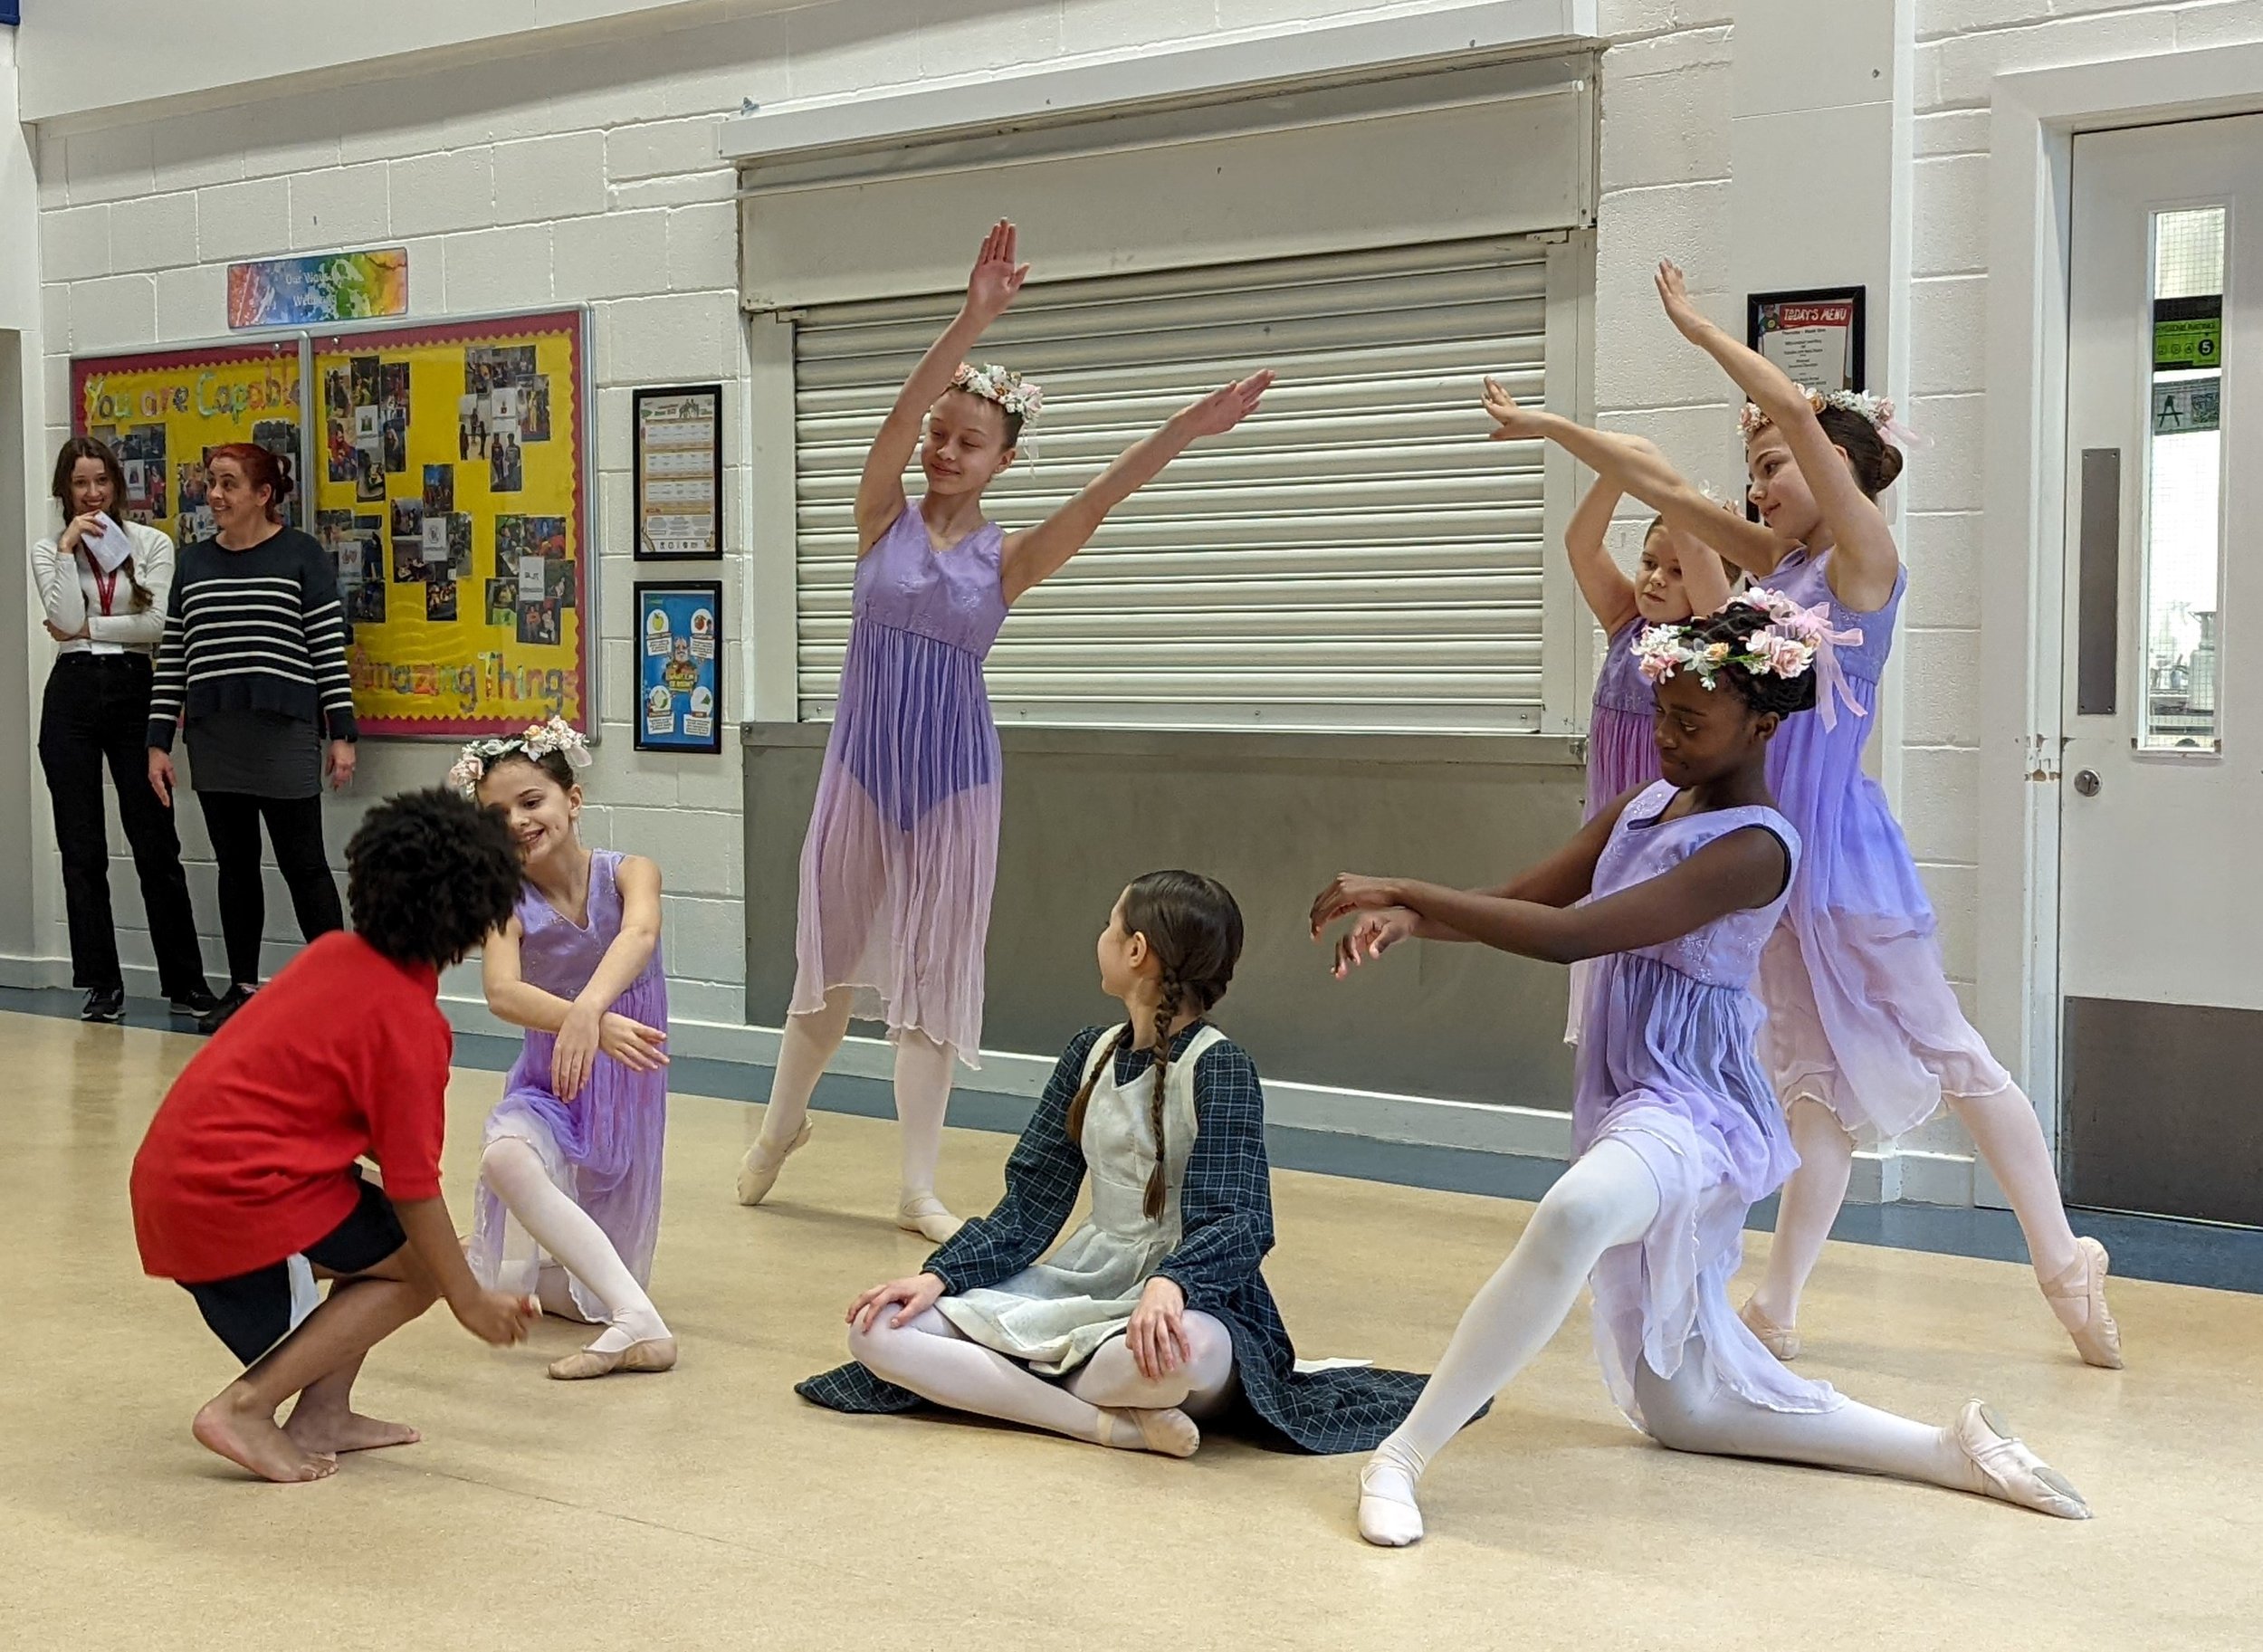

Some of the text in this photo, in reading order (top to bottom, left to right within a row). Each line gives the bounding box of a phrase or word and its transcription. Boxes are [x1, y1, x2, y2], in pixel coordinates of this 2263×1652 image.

[1784, 307, 1848, 321] TODAY'S MENU
[2201, 341, 2211, 354] 5
[86, 376, 133, 422] You
[140, 385, 189, 417] are
